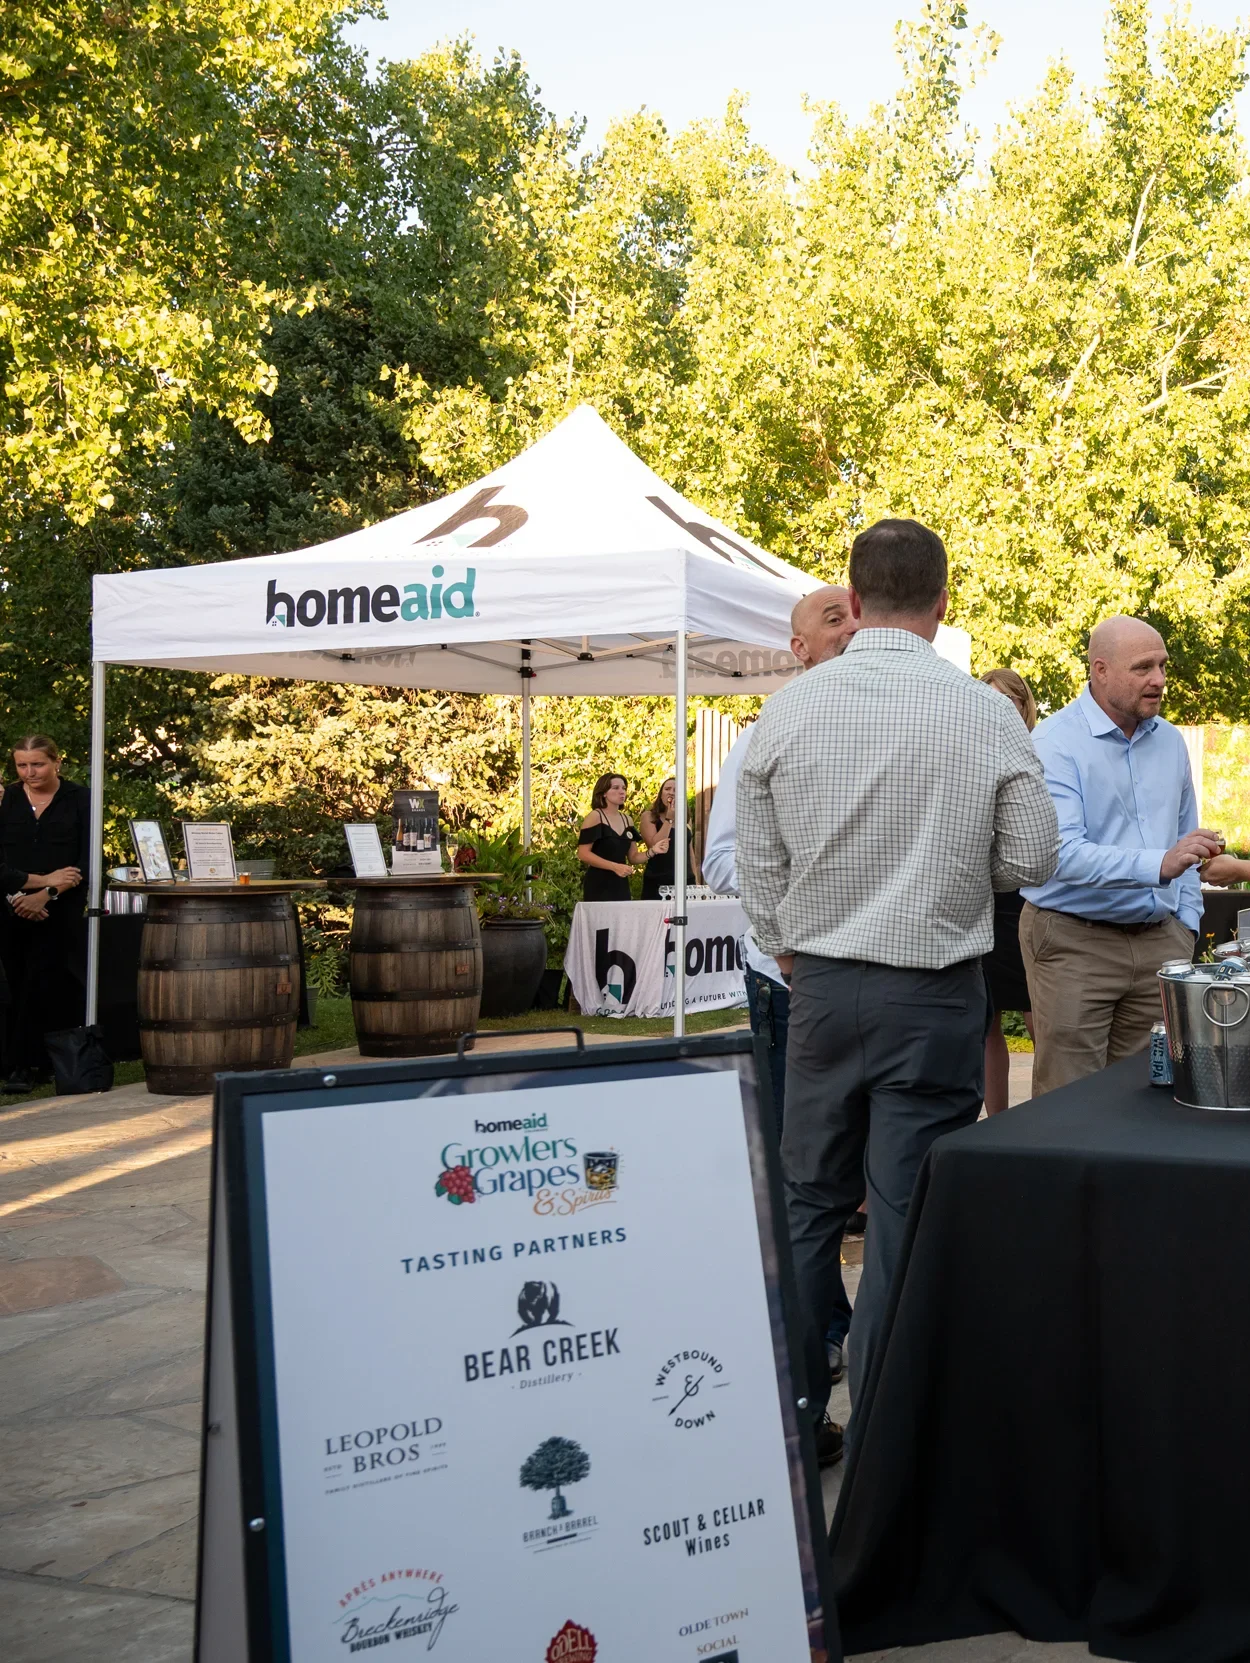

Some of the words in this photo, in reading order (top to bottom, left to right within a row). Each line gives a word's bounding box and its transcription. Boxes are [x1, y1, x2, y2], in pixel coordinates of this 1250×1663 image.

[266, 564, 477, 628] homeaid
[664, 927, 745, 978] hom
[699, 992, 726, 1002] FUTURE
[1152, 1060, 1165, 1078] IPA
[475, 1113, 548, 1133] homeaid
[441, 1136, 577, 1171] Growlers
[474, 1163, 581, 1197] Grapes
[557, 1188, 612, 1215] Spirits
[400, 1245, 503, 1275] TASTING
[513, 1227, 628, 1258] PARTNERS
[464, 1344, 532, 1383] BEAR
[543, 1327, 621, 1367] CREEK
[655, 1349, 724, 1387] WESTBOUND
[519, 1372, 575, 1390] Distillery
[674, 1409, 717, 1430] DOWN
[324, 1417, 443, 1456] LEOPOLD
[352, 1443, 421, 1474] BROS
[522, 1523, 559, 1543] BRANCH
[564, 1515, 599, 1533] BARREL
[643, 1517, 690, 1546] SCOUT
[697, 1512, 708, 1532] &
[713, 1498, 766, 1528] CELLAR
[685, 1532, 731, 1557] Wines
[380, 1568, 444, 1585] ANYWHERE
[341, 1586, 460, 1652] Breckenridge
[679, 1619, 712, 1637] OLDE
[713, 1607, 749, 1627] TOWN
[350, 1633, 391, 1653] BOURBON
[394, 1621, 433, 1641] WHISKEY
[696, 1634, 740, 1656] SOCIAL
